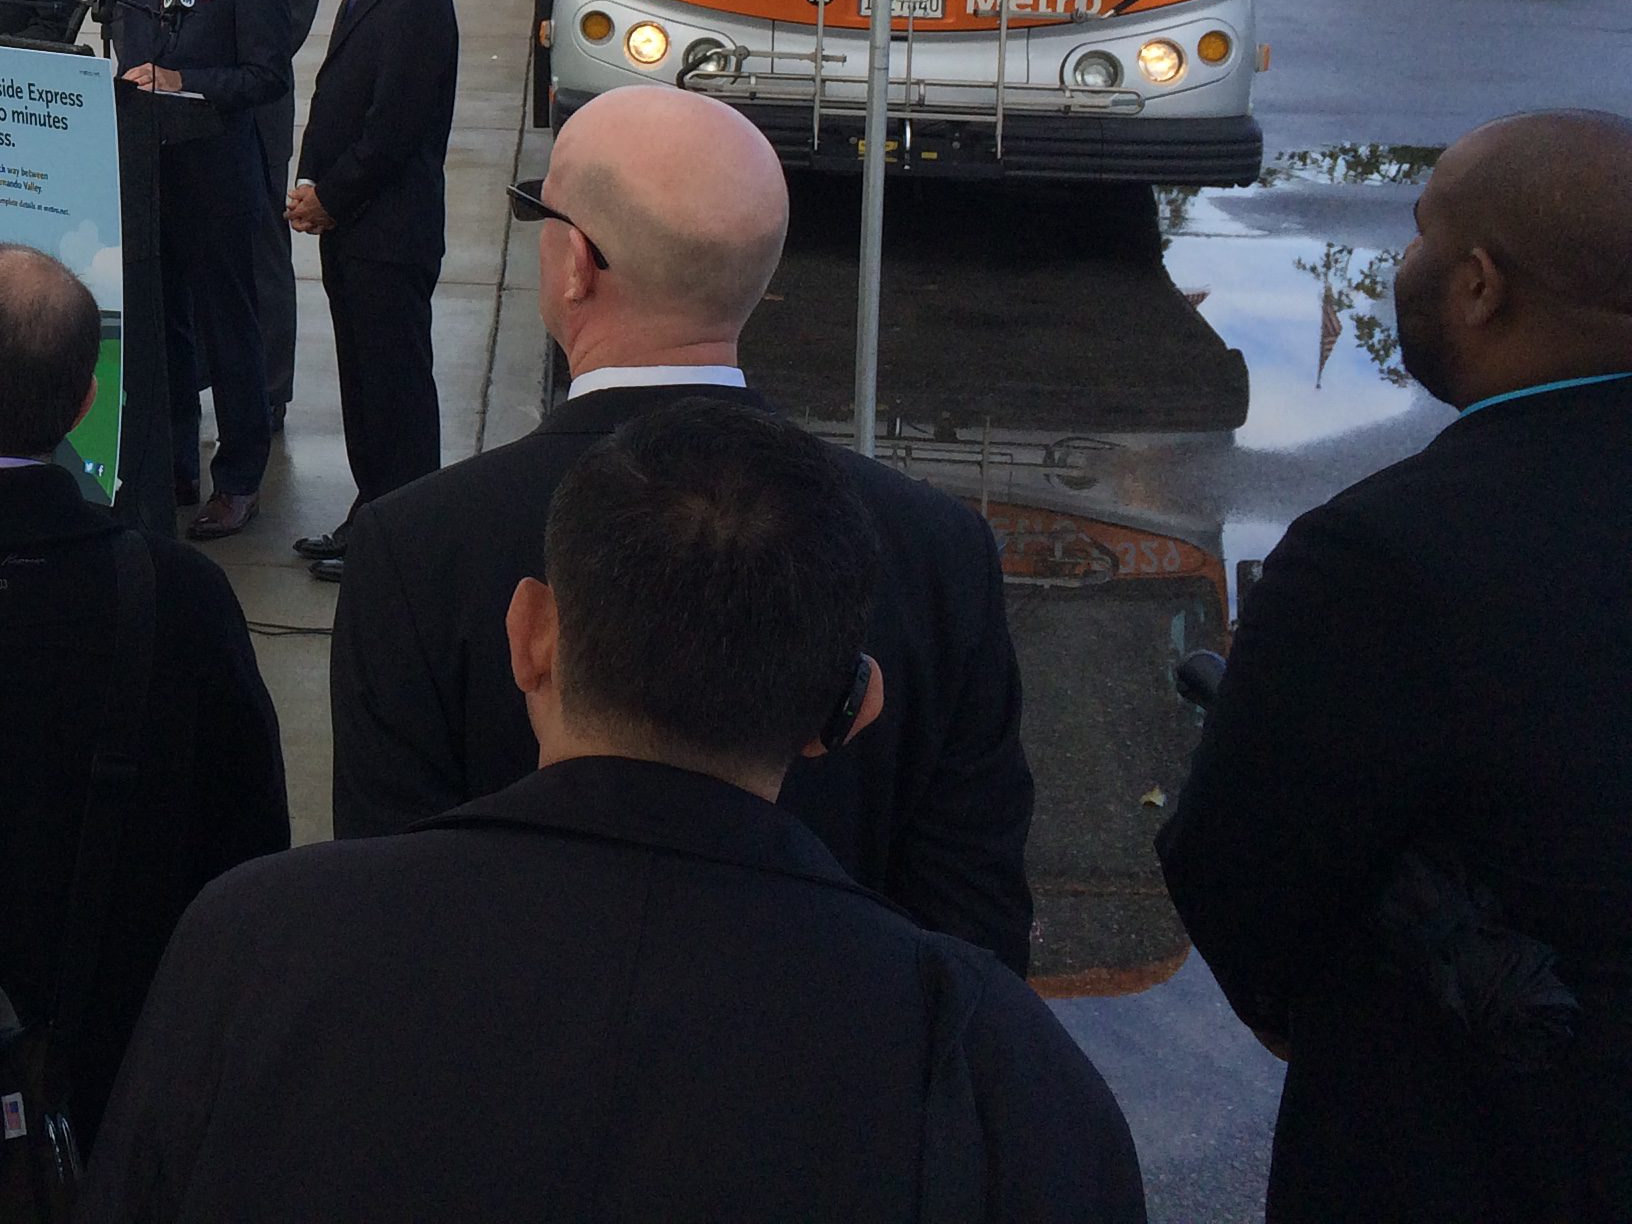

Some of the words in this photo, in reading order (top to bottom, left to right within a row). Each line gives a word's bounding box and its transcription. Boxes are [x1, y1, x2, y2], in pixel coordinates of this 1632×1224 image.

[28, 82, 84, 108] Express
[11, 106, 69, 130] minutes
[7, 167, 19, 177] way
[21, 166, 48, 180] between
